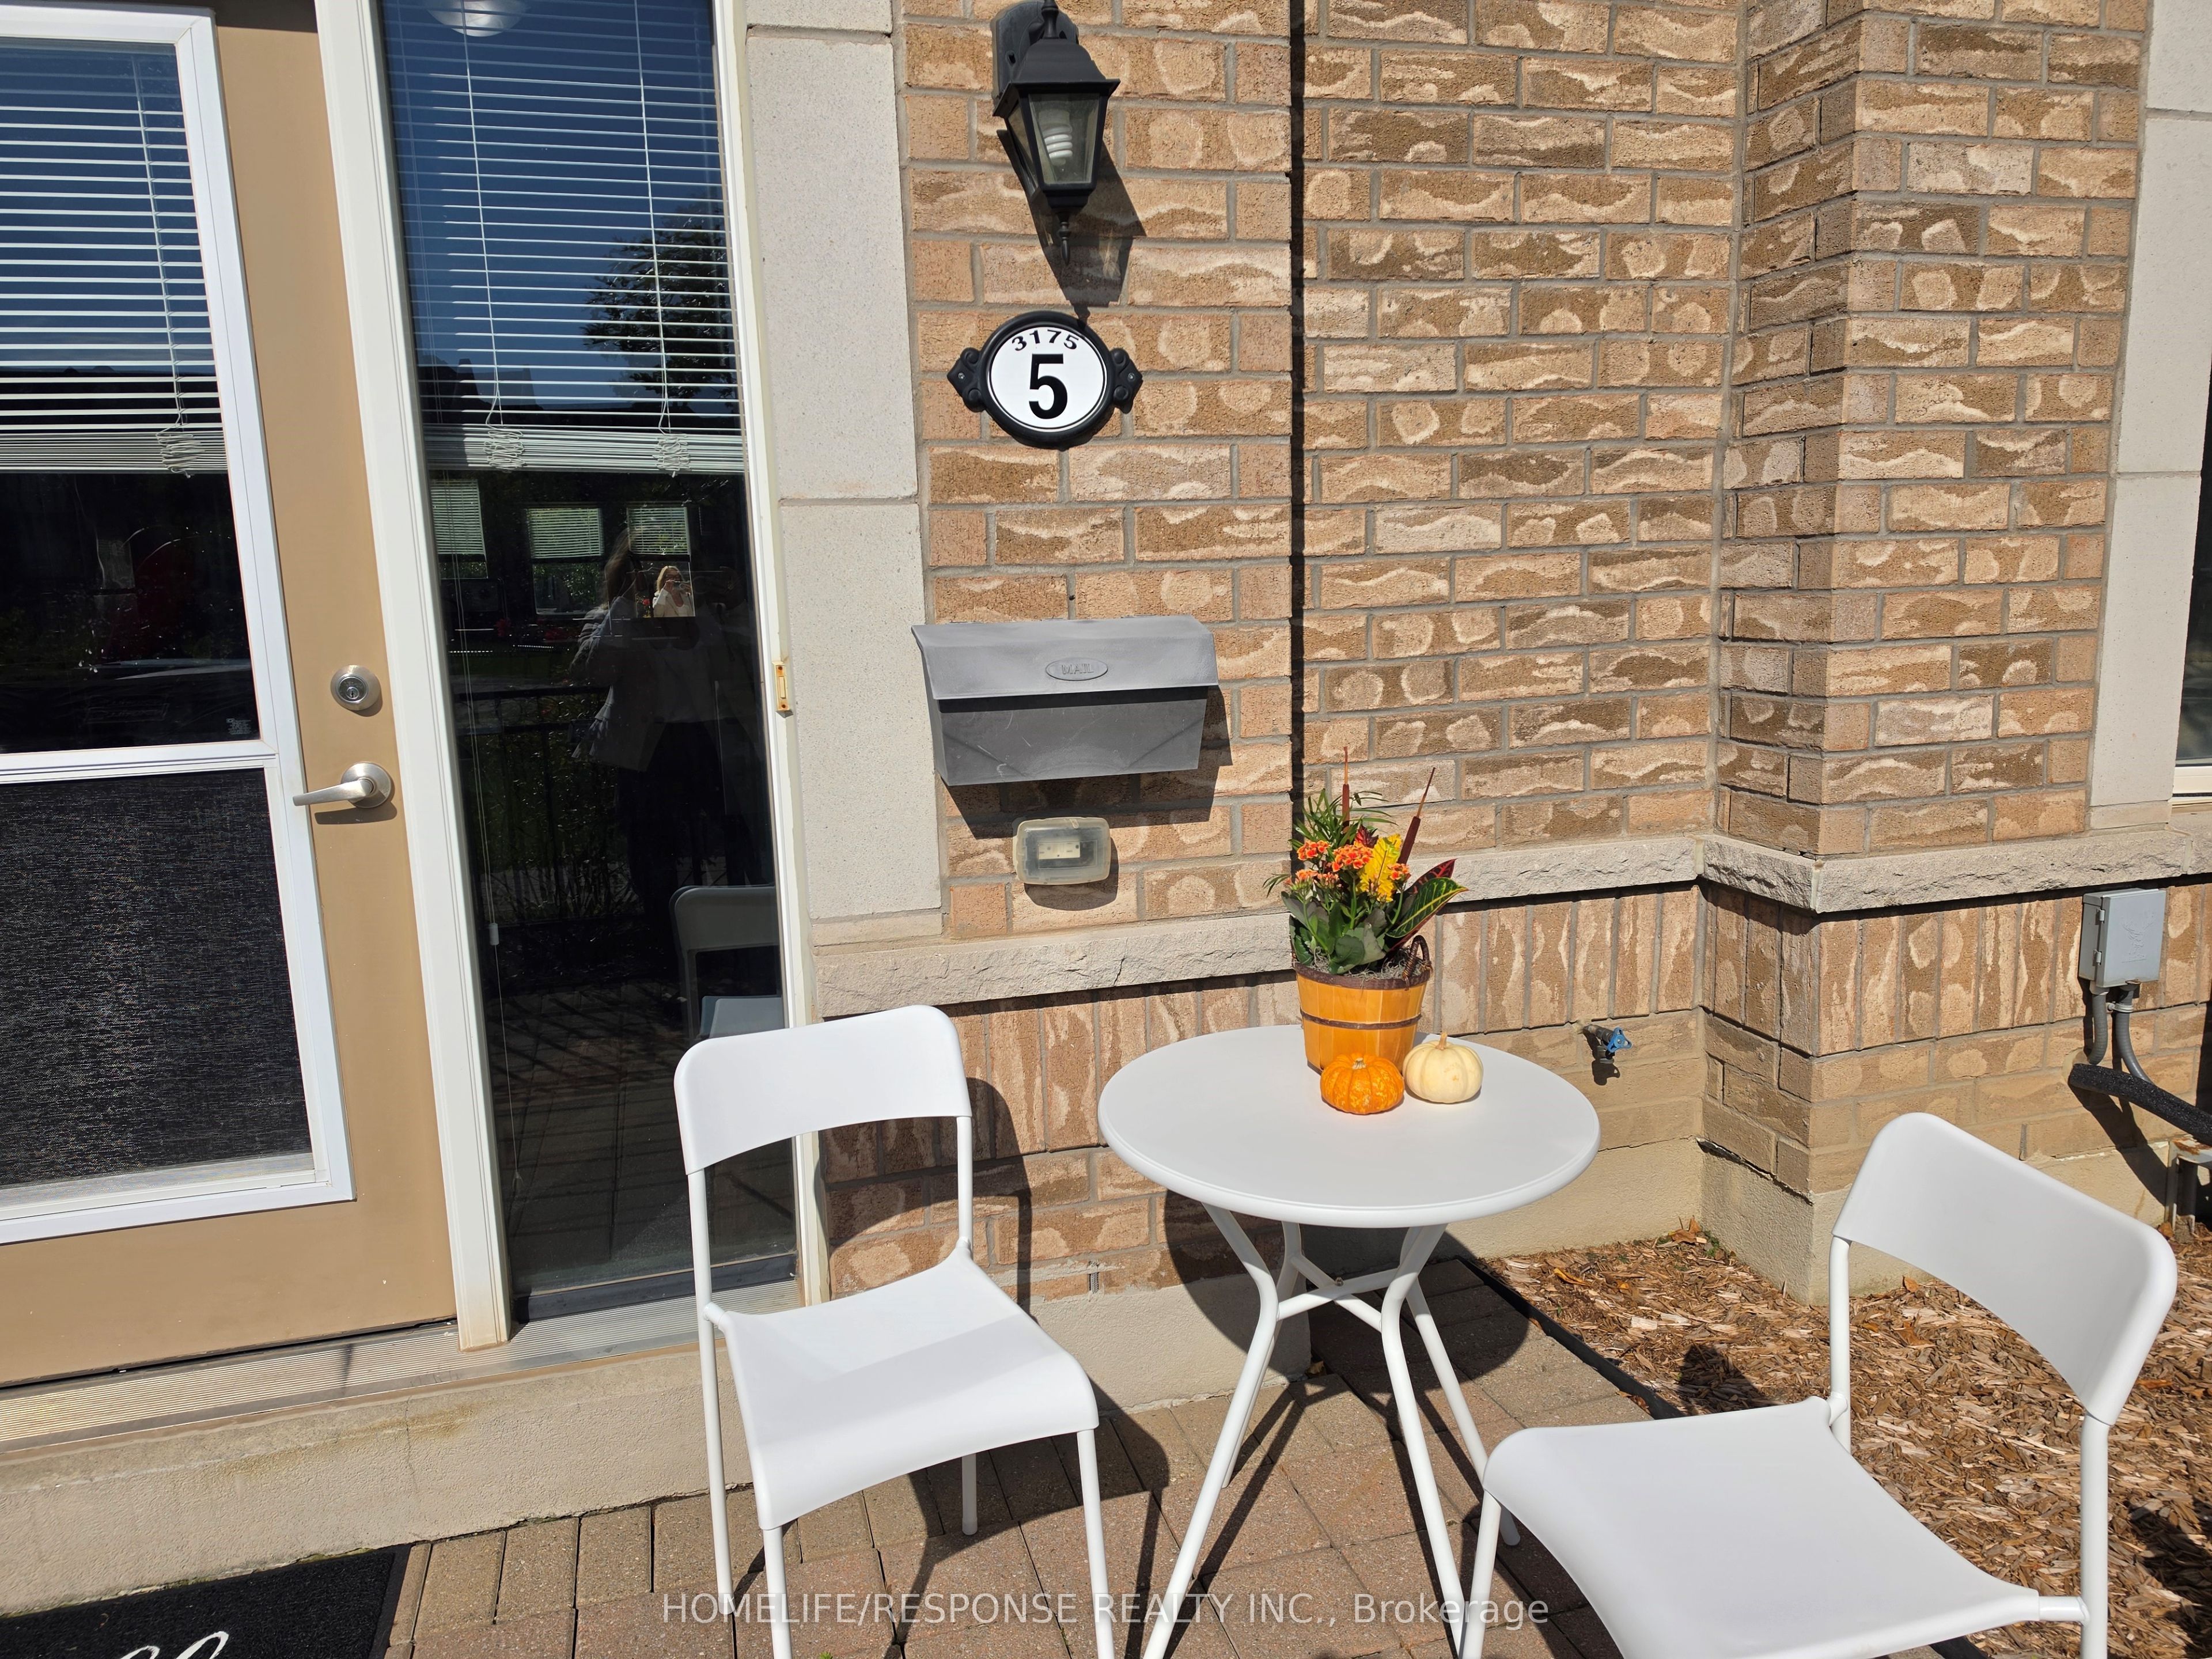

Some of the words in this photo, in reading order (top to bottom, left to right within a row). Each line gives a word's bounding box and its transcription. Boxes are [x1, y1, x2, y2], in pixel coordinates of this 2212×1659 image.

[1012, 329, 1079, 351] 3175
[1029, 354, 1067, 419] 5
[1061, 663, 1094, 675] MAIL
